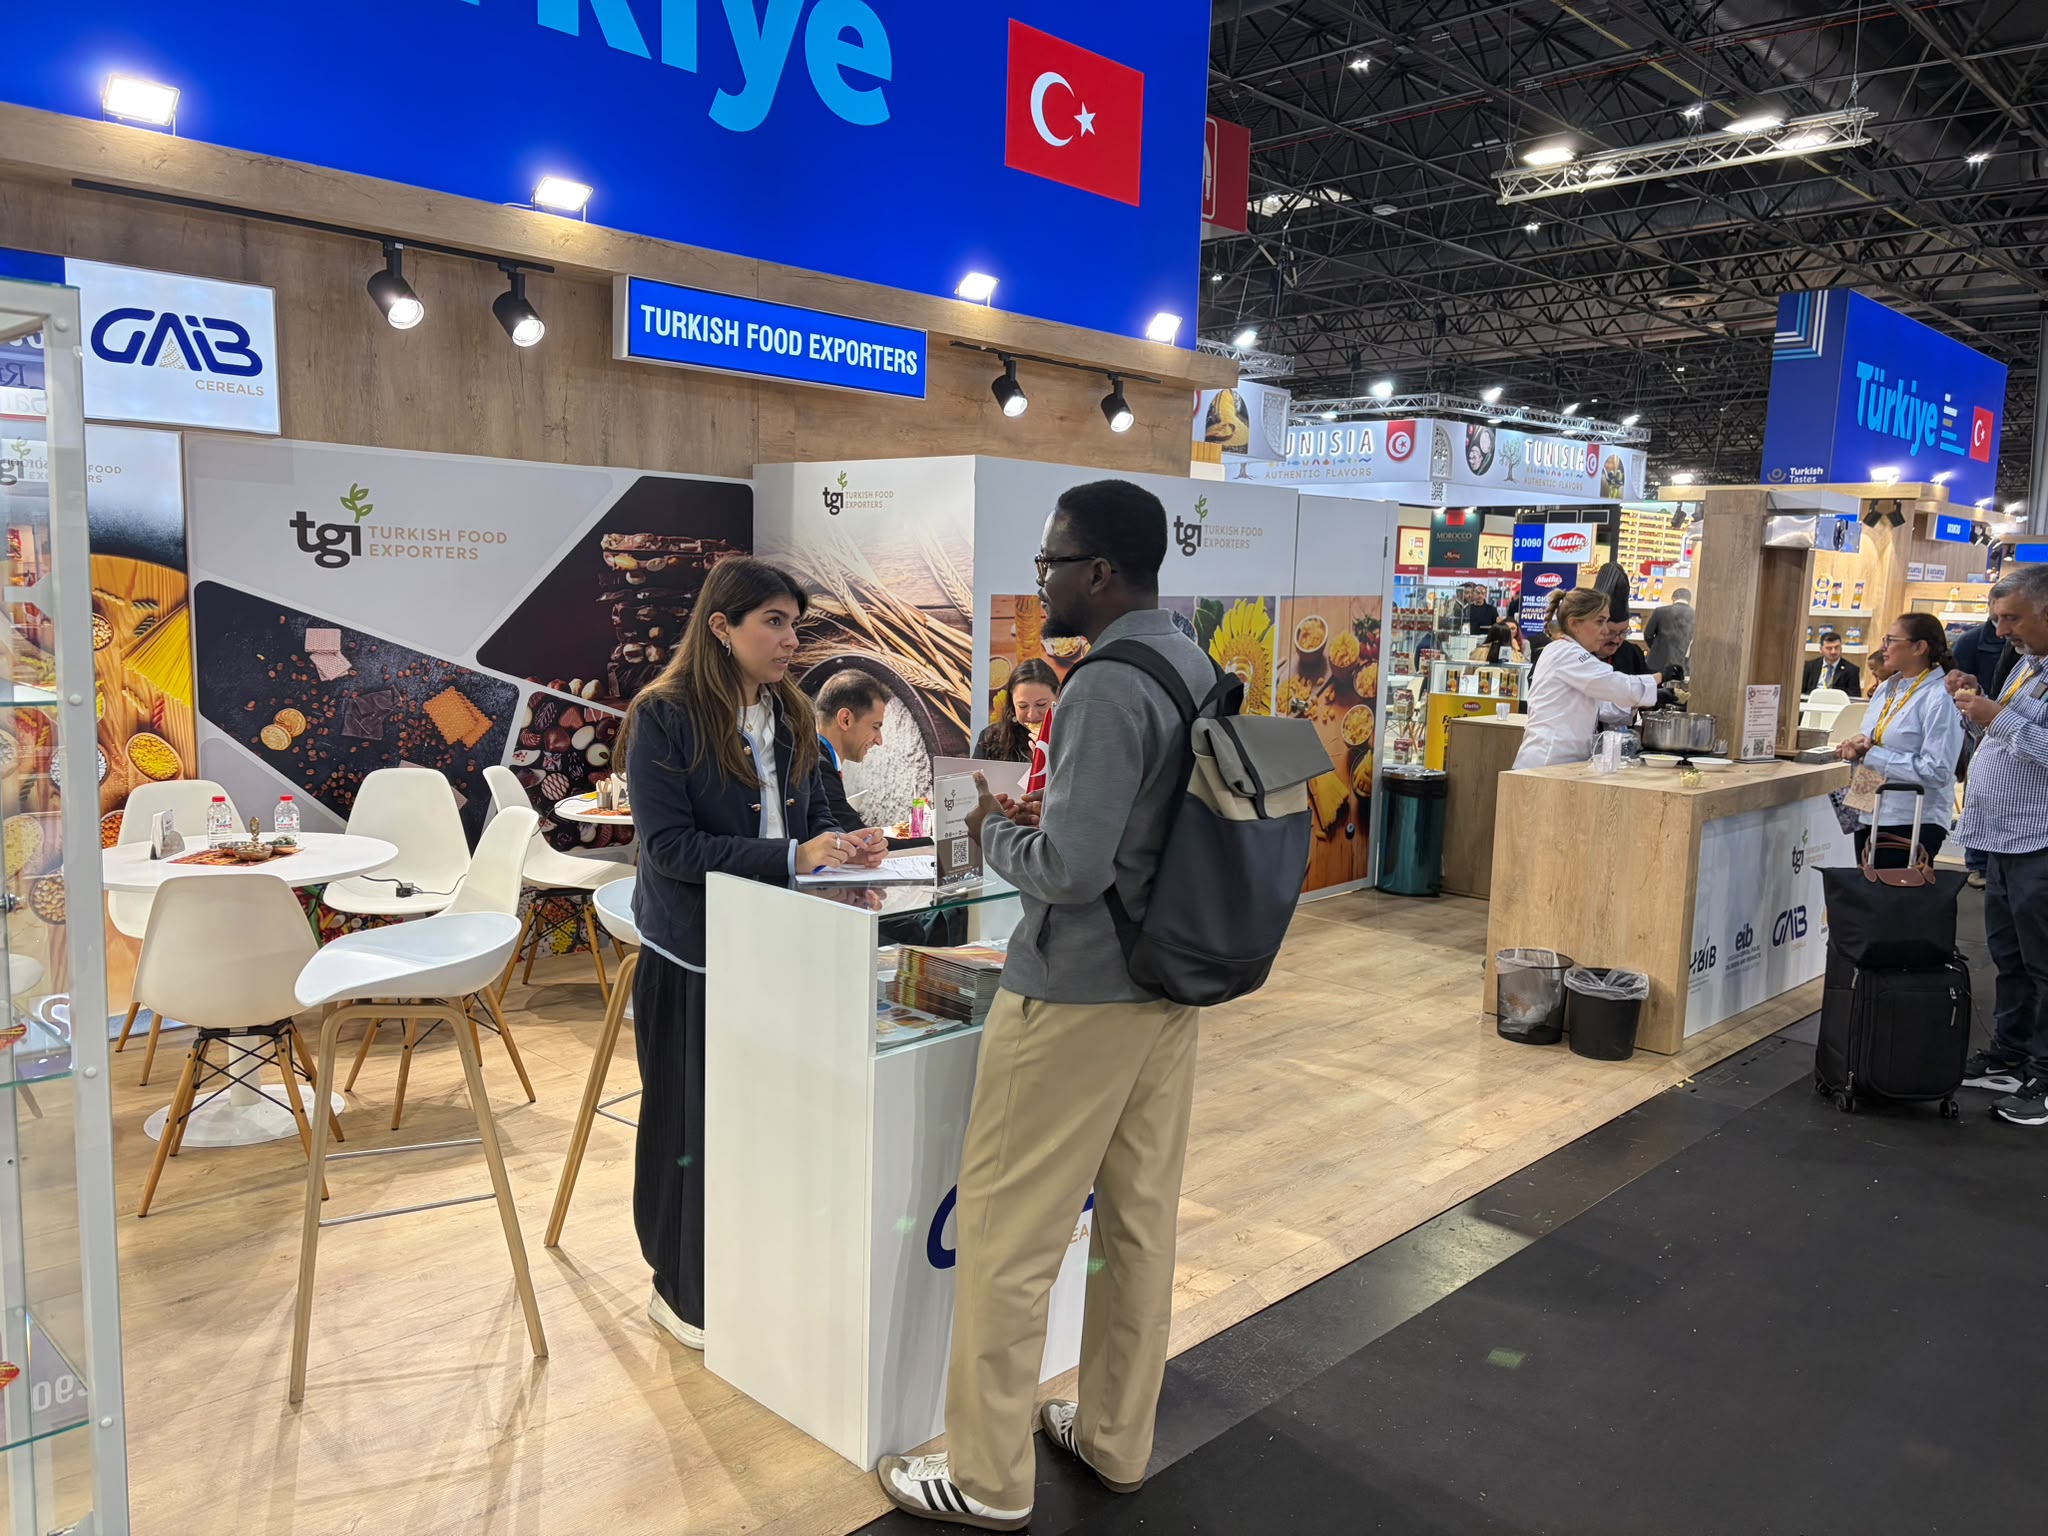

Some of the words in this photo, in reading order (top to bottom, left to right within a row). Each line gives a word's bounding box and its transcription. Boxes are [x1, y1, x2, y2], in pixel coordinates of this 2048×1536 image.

[641, 305, 739, 347] TURKISH
[747, 323, 802, 356] FOOD
[809, 334, 918, 375] EXPORTERS
[195, 379, 264, 396] CEREALS
[1856, 361, 1938, 456] Türkiye
[1286, 428, 1374, 456] UNISIA
[1525, 439, 1585, 471] TUNISIA
[88, 465, 121, 473] FOOD
[1265, 469, 1320, 479] AUTHENTIC
[1326, 467, 1372, 477] FLAVORS
[1790, 467, 1823, 475] Turkish
[822, 487, 843, 515] tgi
[845, 491, 873, 500] TURKISH
[875, 490, 894, 499] FOOD
[845, 500, 883, 509] EXPORTERS
[368, 526, 450, 542] TURKISH
[458, 530, 507, 544] FOOD
[1173, 515, 1202, 556] tgi
[1204, 526, 1238, 537] TURKISH
[1241, 527, 1263, 537] FOOD
[1436, 531, 1472, 540] MOROCCO
[289, 511, 362, 569] tgi
[1204, 538, 1250, 549] EXPORTERS
[1514, 538, 1520, 548] 3
[1522, 538, 1542, 548] D090
[1550, 535, 1585, 548] Mutlu
[369, 544, 479, 560] EXPORTERS
[1735, 922, 1753, 951] eib
